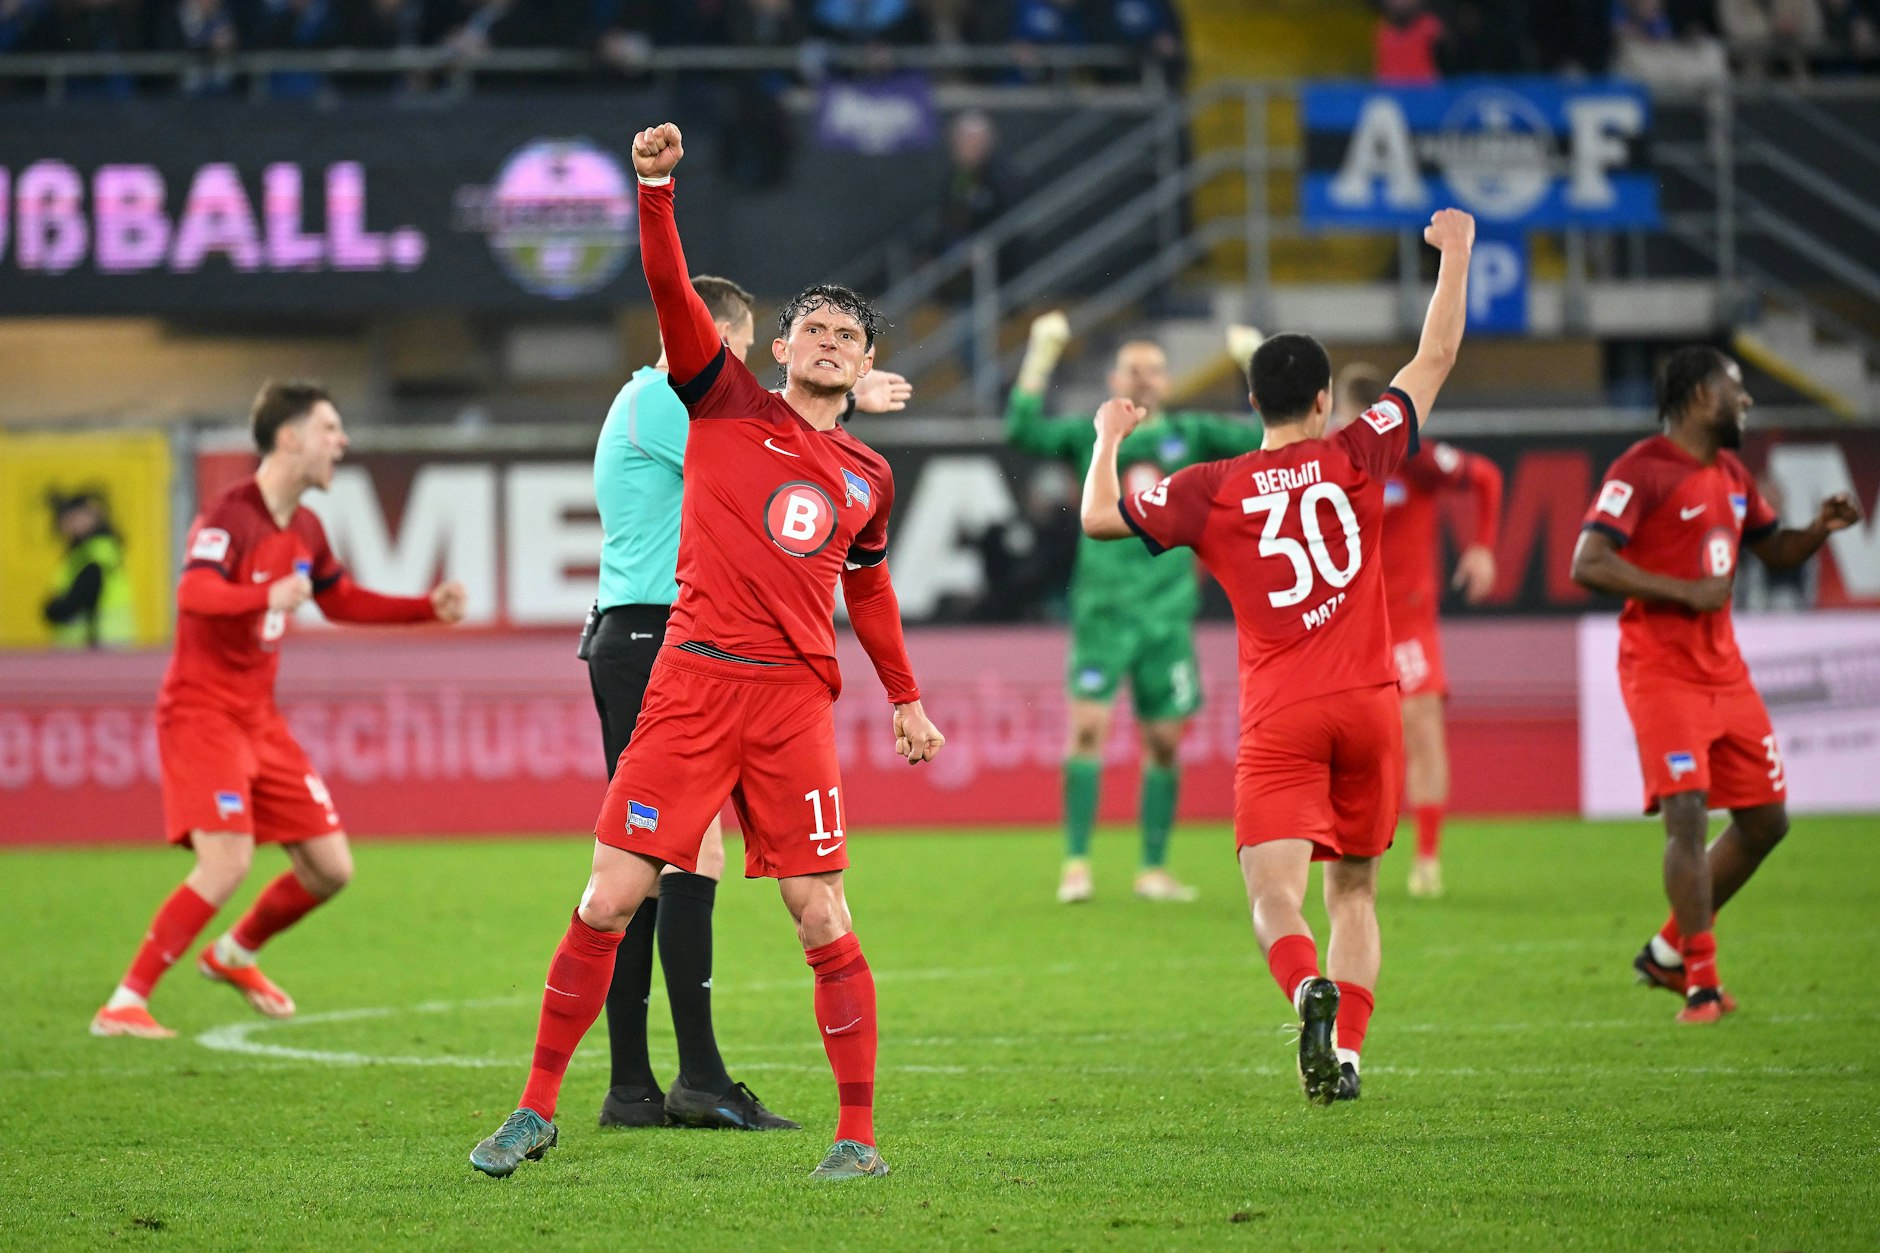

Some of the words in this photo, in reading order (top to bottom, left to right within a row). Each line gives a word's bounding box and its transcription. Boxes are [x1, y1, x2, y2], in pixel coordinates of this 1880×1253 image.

[1328, 93, 1429, 205] A
[1567, 97, 1645, 207] F
[0, 158, 428, 274] ßBALL.
[1468, 243, 1522, 323] P
[781, 494, 819, 541] B
[1241, 481, 1362, 608] 30
[1707, 538, 1732, 577] B
[804, 786, 844, 840] 11
